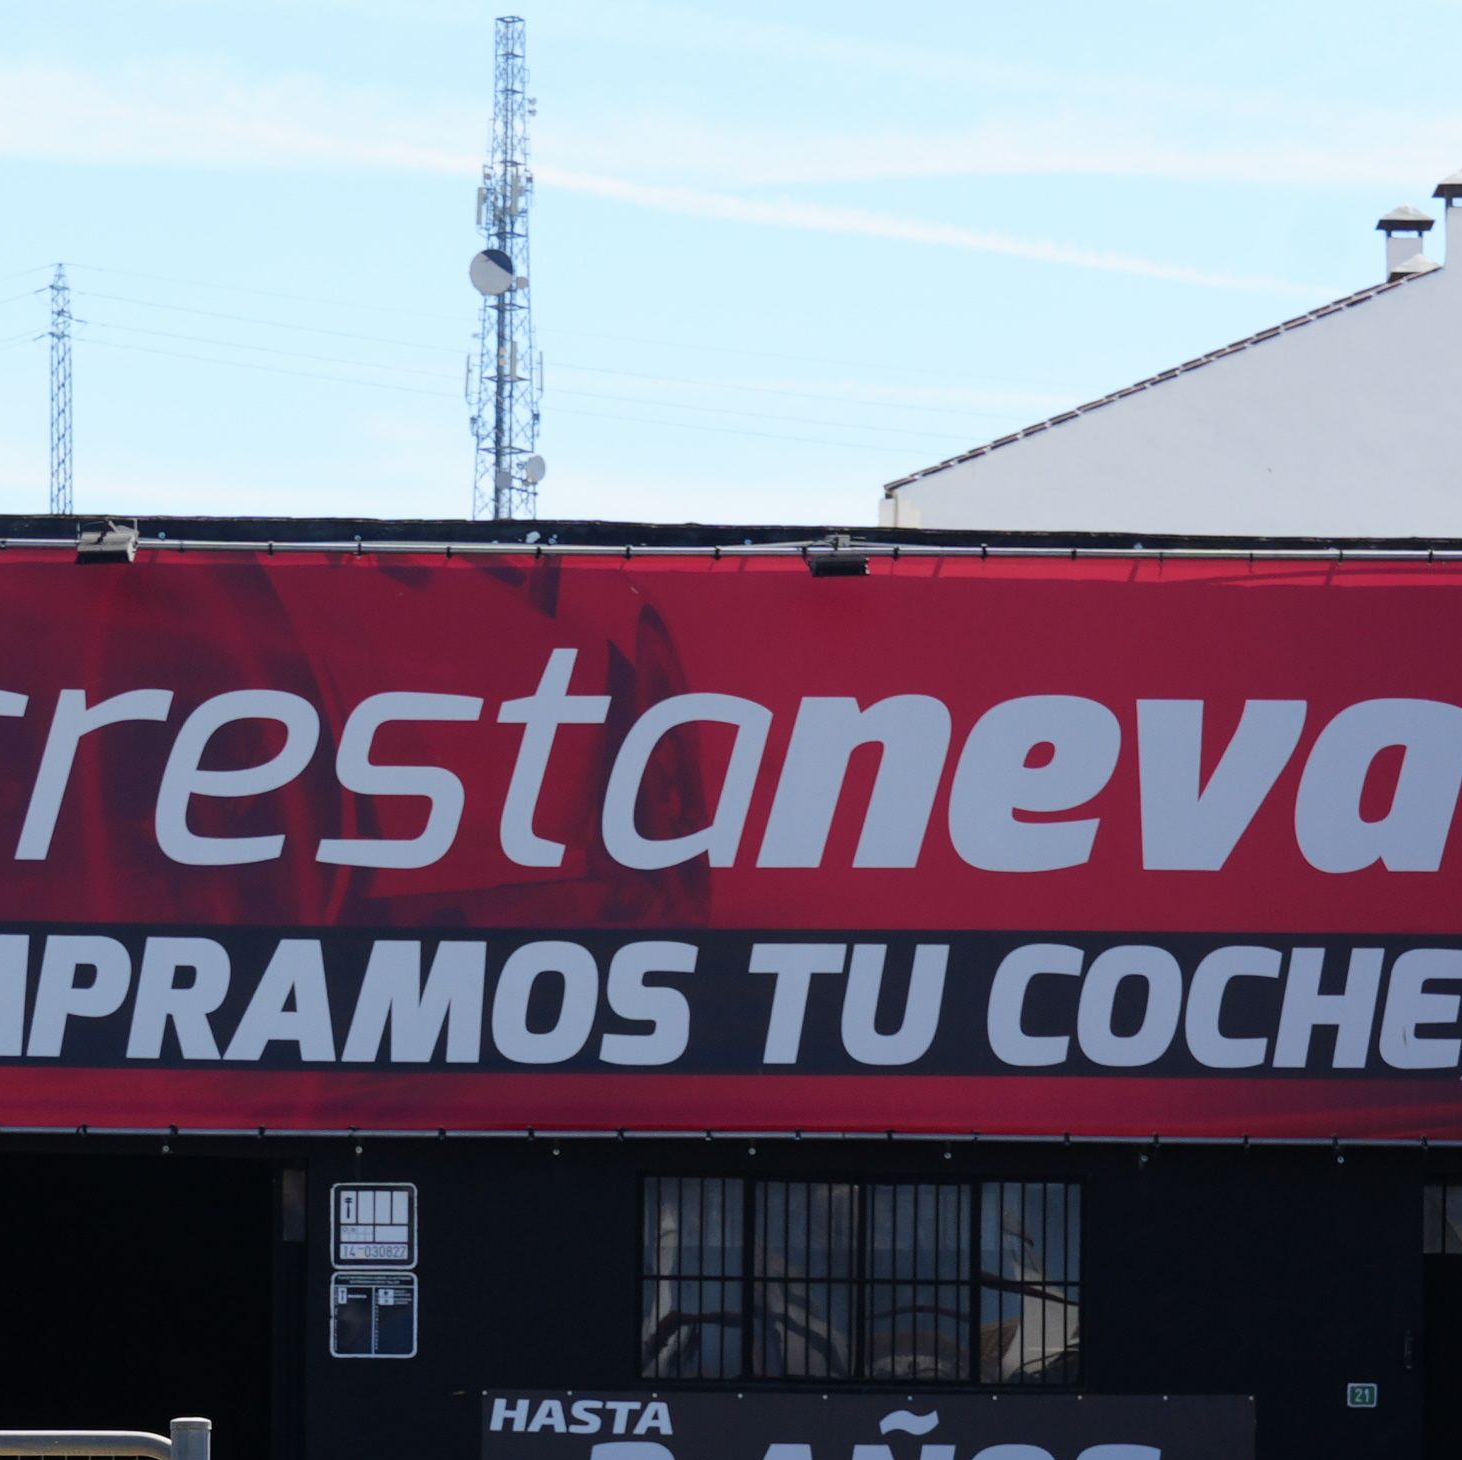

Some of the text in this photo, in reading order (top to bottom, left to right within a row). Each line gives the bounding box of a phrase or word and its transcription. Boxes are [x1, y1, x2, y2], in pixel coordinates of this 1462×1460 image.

[748, 943, 950, 1065] TU
[1354, 1387, 1370, 1403] 21
[488, 1397, 674, 1435] HASTA
